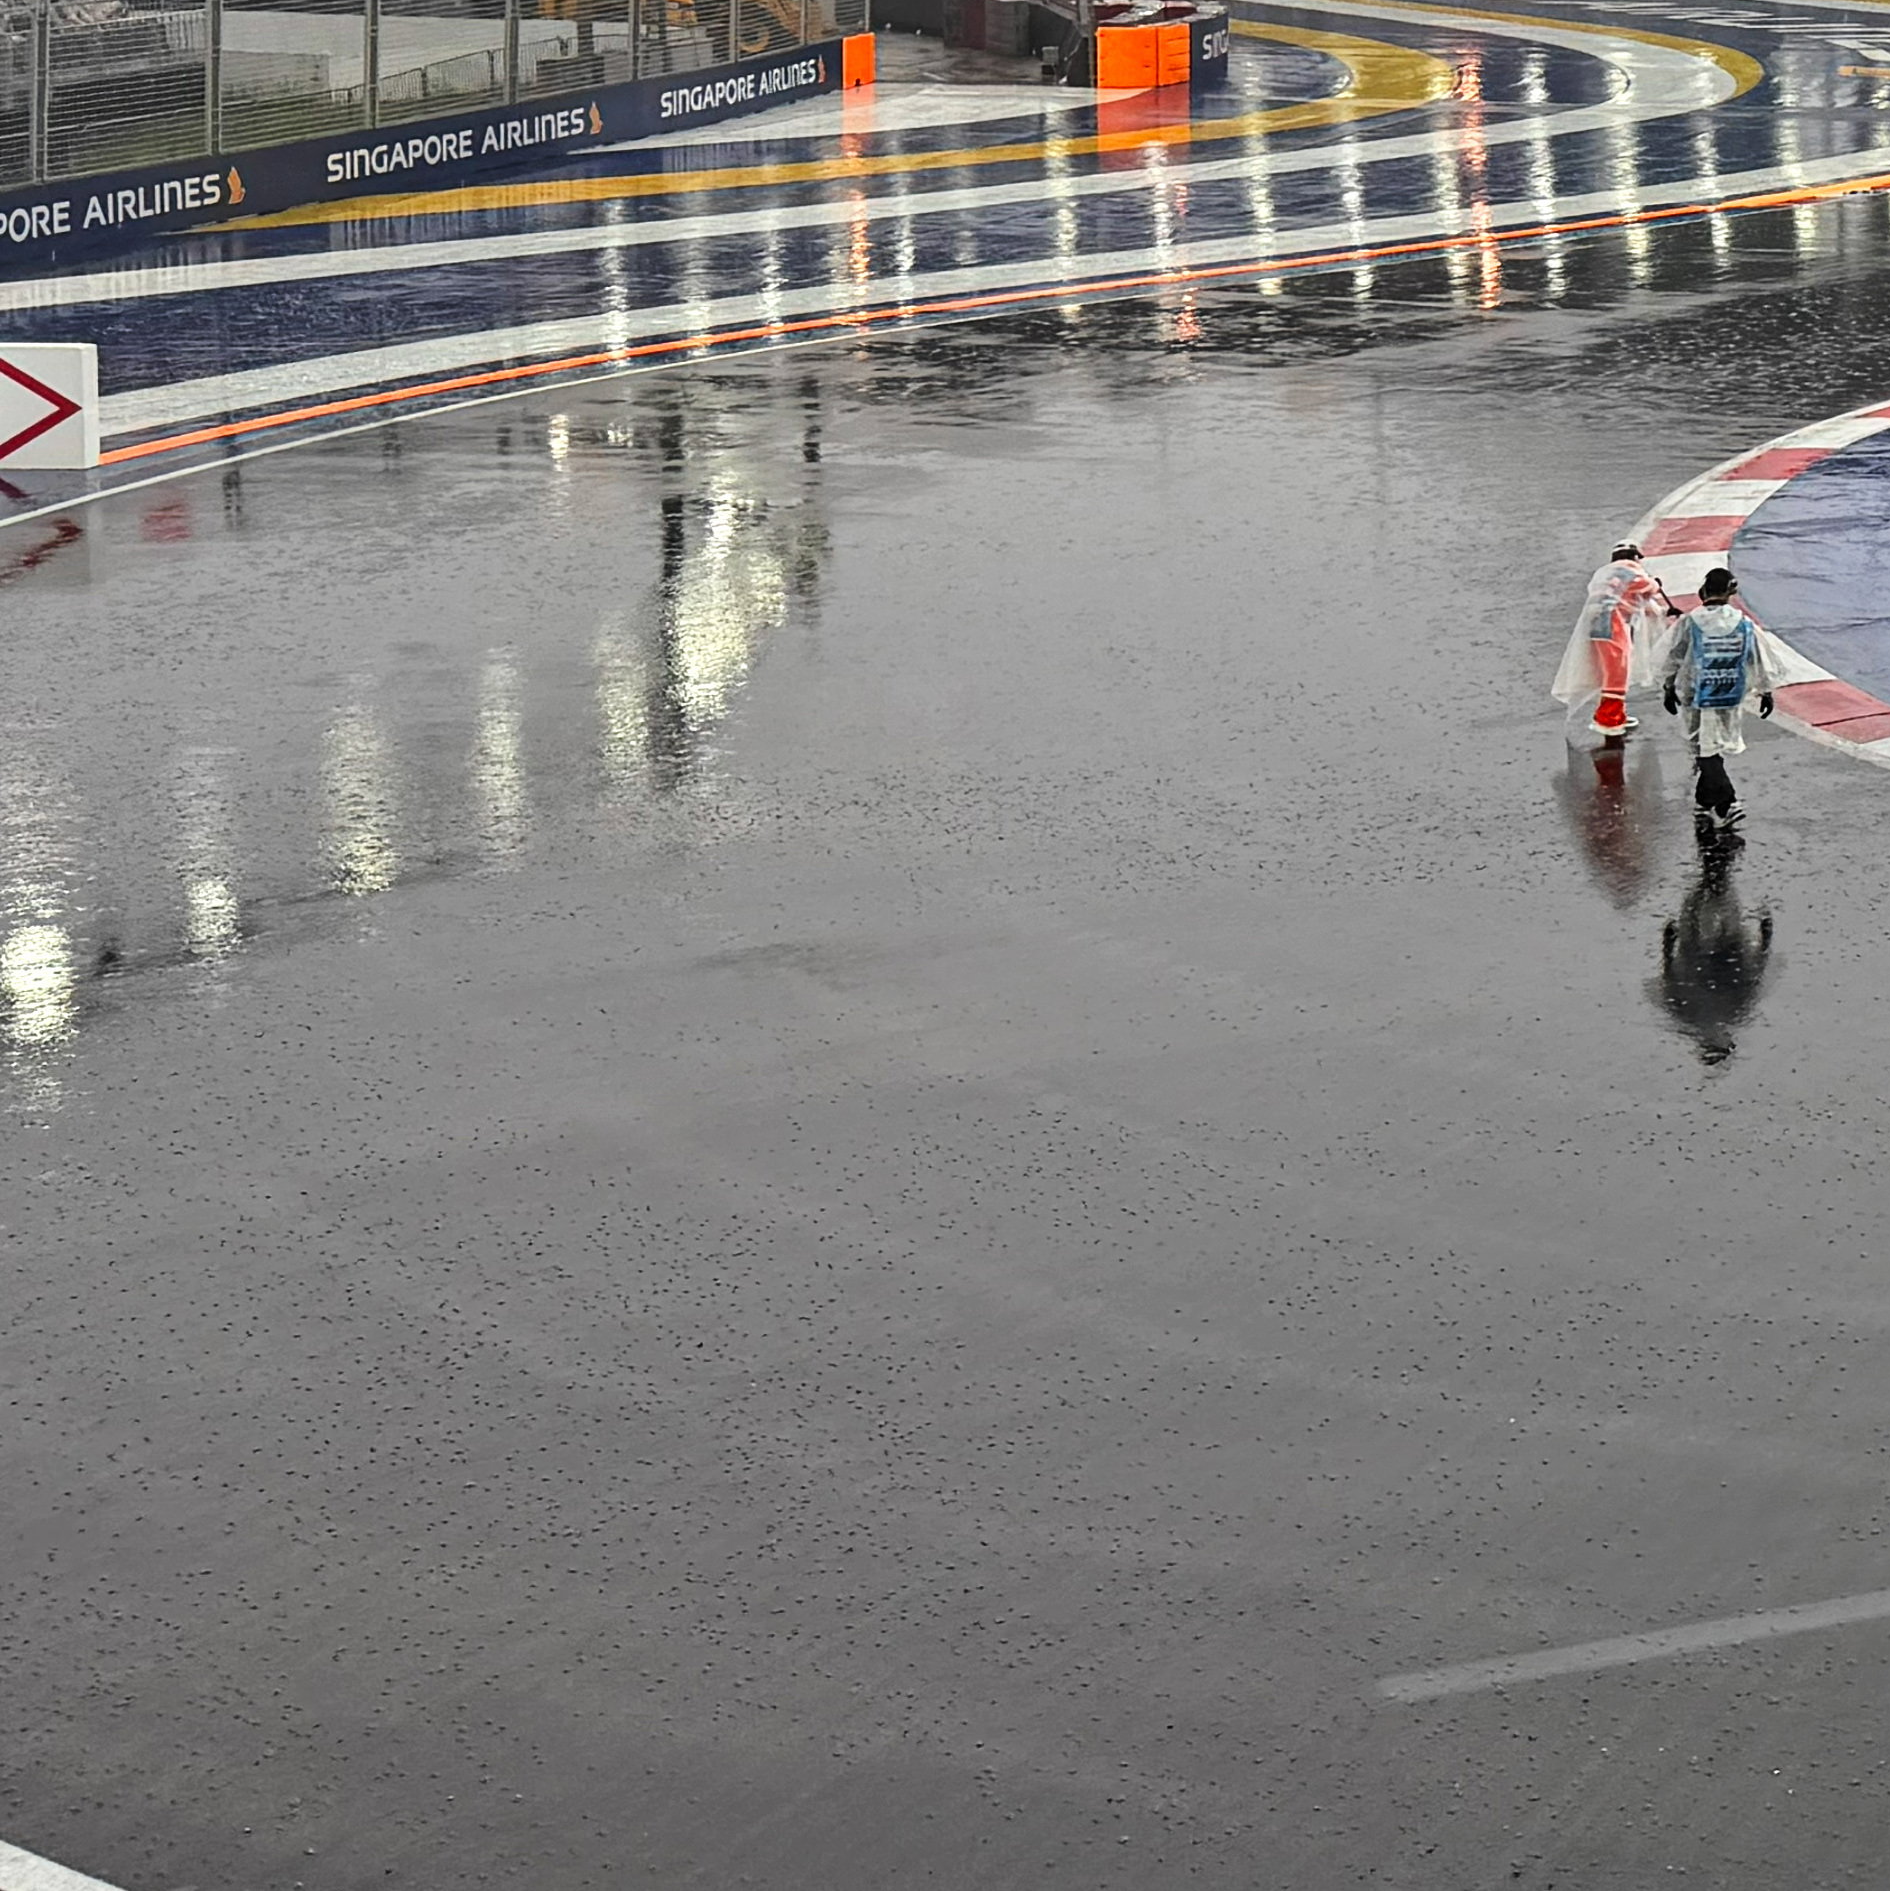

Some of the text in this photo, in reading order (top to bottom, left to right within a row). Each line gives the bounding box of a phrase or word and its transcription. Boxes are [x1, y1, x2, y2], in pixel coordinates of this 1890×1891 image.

[661, 59, 816, 118] SINGAPORE AIRLINES
[327, 106, 585, 183] SINGAPORE AIRLINES
[83, 173, 221, 229] AIRLINES
